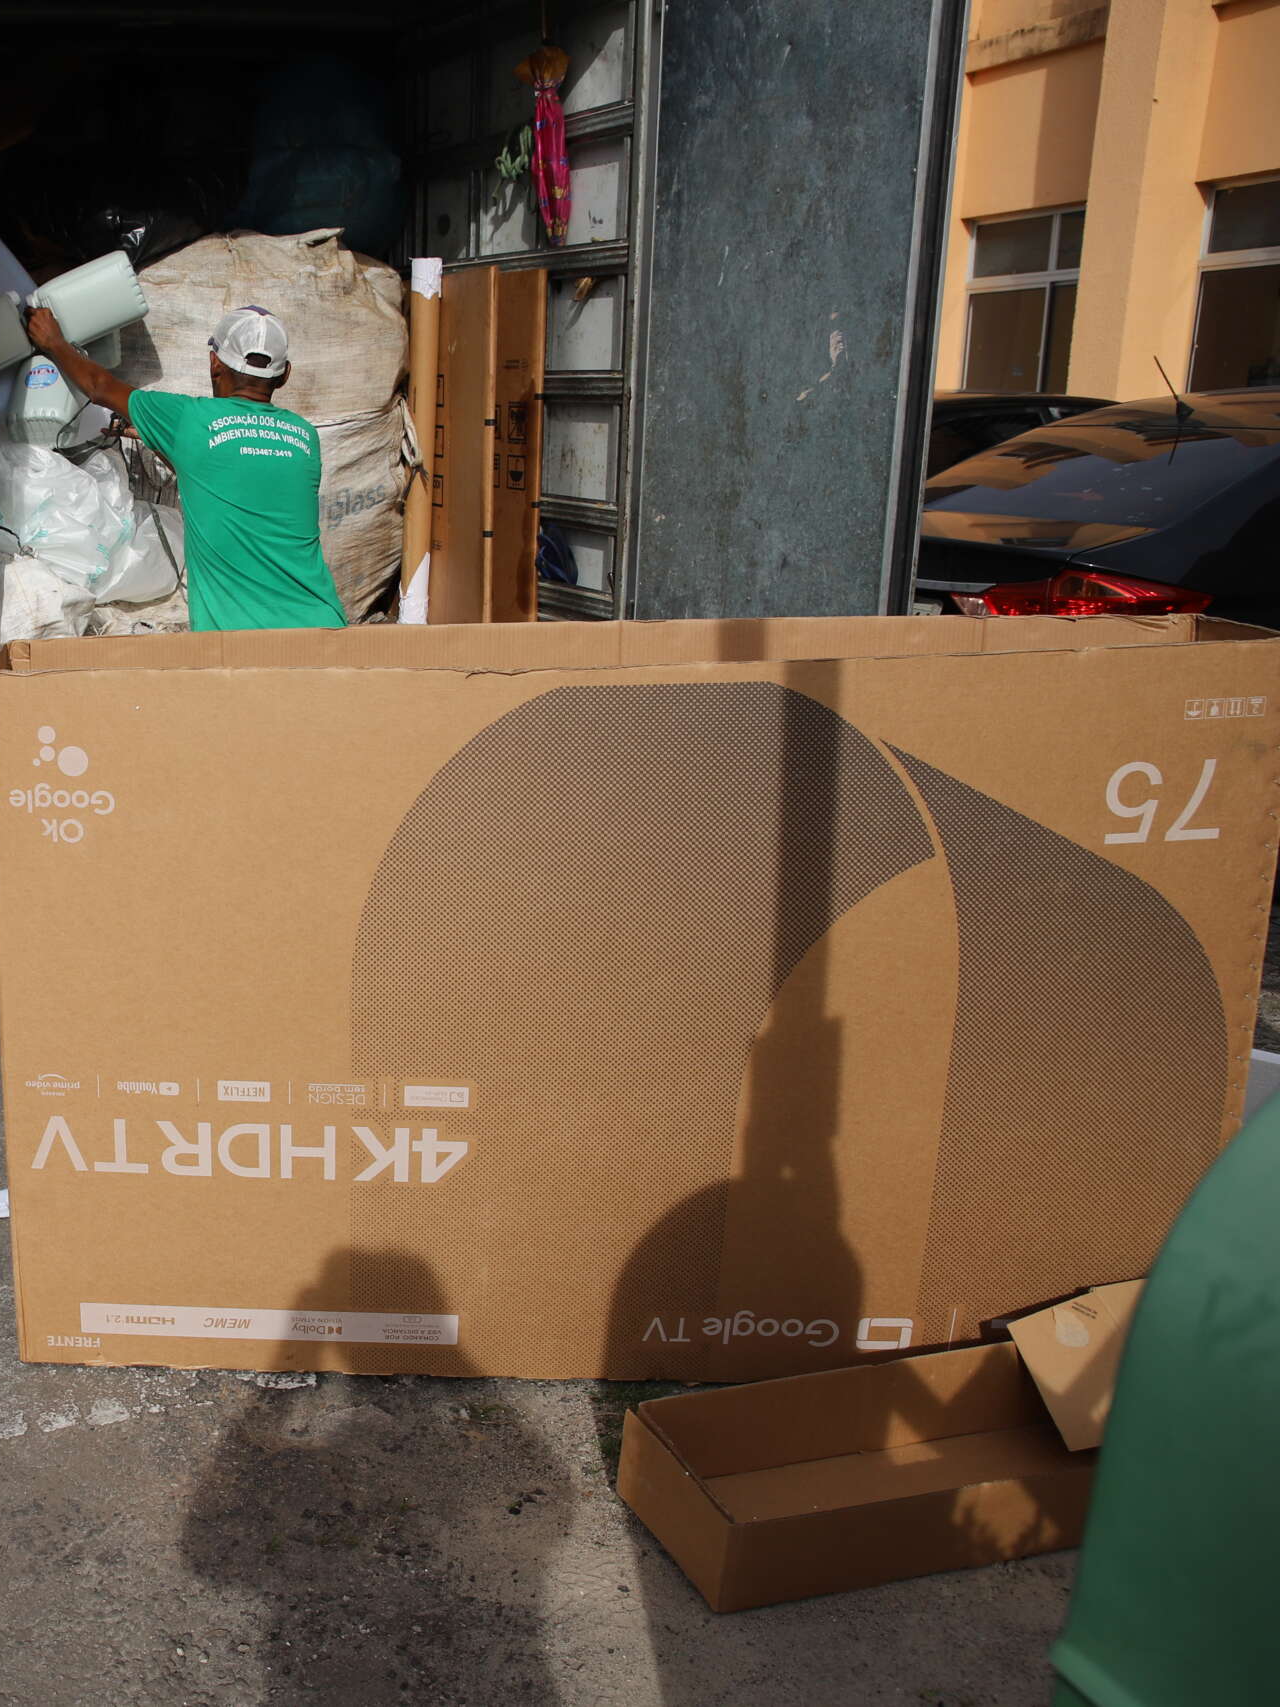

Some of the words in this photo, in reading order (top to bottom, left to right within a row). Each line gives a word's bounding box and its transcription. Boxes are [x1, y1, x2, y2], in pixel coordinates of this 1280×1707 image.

[260, 415, 275, 428] DOS
[276, 419, 310, 441] AGENTES
[208, 428, 258, 448] AMBIENTAIS
[260, 429, 281, 441] ROSA
[8, 782, 116, 815] Google
[1103, 758, 1220, 845] 75
[41, 818, 85, 843] Ok
[51, 1080, 81, 1090] prime
[117, 1080, 159, 1095] YouTube
[223, 1085, 265, 1097] NETFLIX
[307, 1094, 366, 1105] DESIGN
[352, 1126, 468, 1183] 4K
[105, 1313, 121, 1324] 2.1
[125, 1314, 176, 1326] HDMI
[202, 1317, 253, 1329] MEMC
[291, 1322, 326, 1335] Dolby
[642, 1317, 691, 1342] TV
[702, 1310, 840, 1347] Google
[47, 1335, 101, 1348] FRENTE
